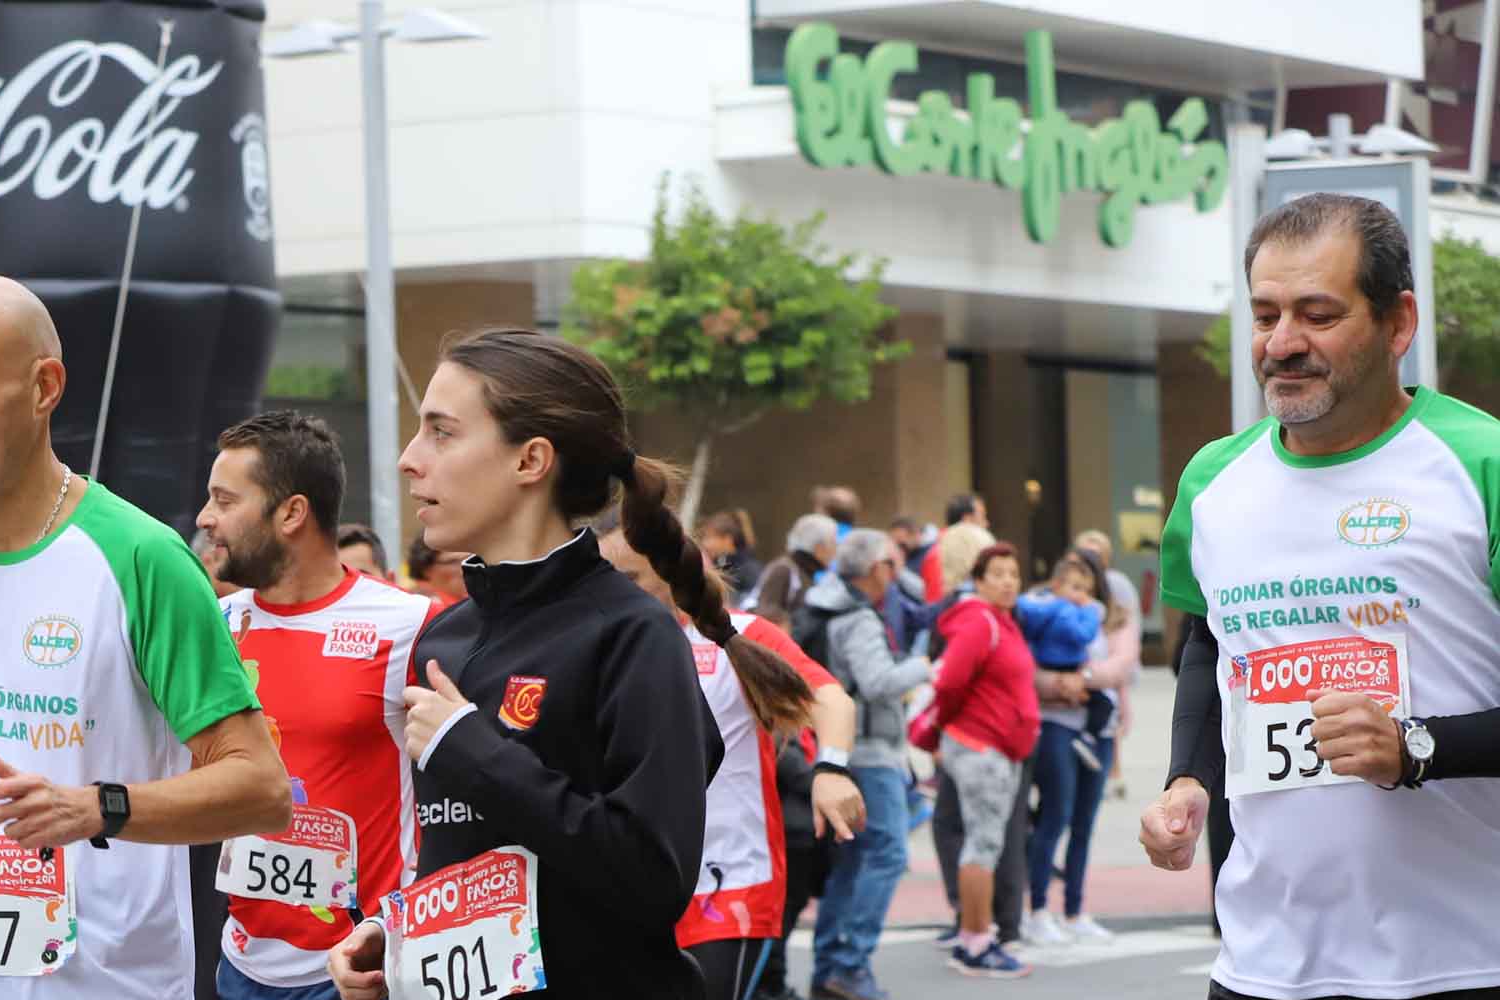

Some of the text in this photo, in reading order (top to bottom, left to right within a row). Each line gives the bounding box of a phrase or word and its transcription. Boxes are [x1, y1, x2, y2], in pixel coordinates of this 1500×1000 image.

[1289, 570, 1398, 598] ÓRGANOS
[1222, 616, 1242, 634] ES
[1246, 606, 1340, 630] REGALAR
[330, 642, 373, 655] PASOS
[332, 628, 377, 645] 1000
[1321, 659, 1389, 680] PASOS
[1370, 676, 1390, 686] 2019
[1266, 718, 1325, 781] 53
[294, 819, 344, 836] PASOS
[246, 850, 317, 899] 584
[467, 870, 517, 902] PASOS
